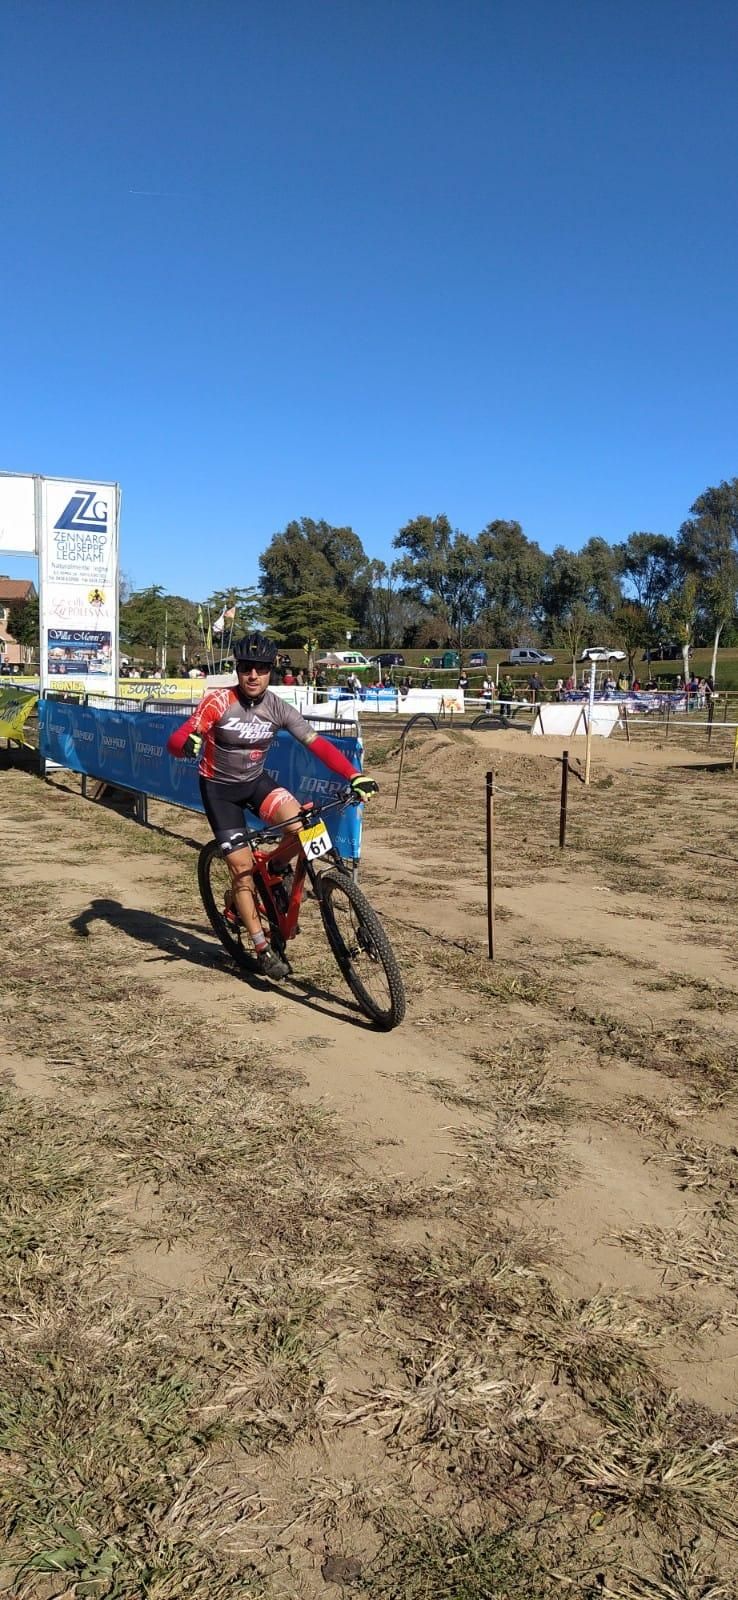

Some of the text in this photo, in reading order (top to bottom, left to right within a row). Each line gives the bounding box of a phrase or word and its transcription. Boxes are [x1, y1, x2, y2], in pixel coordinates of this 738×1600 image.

[53, 532, 108, 545] ZENNARO
[56, 542, 105, 553] GIUSEPPE
[56, 551, 104, 562] LEGNAMI
[127, 683, 178, 695] SORRISO
[310, 837, 327, 856] 61
